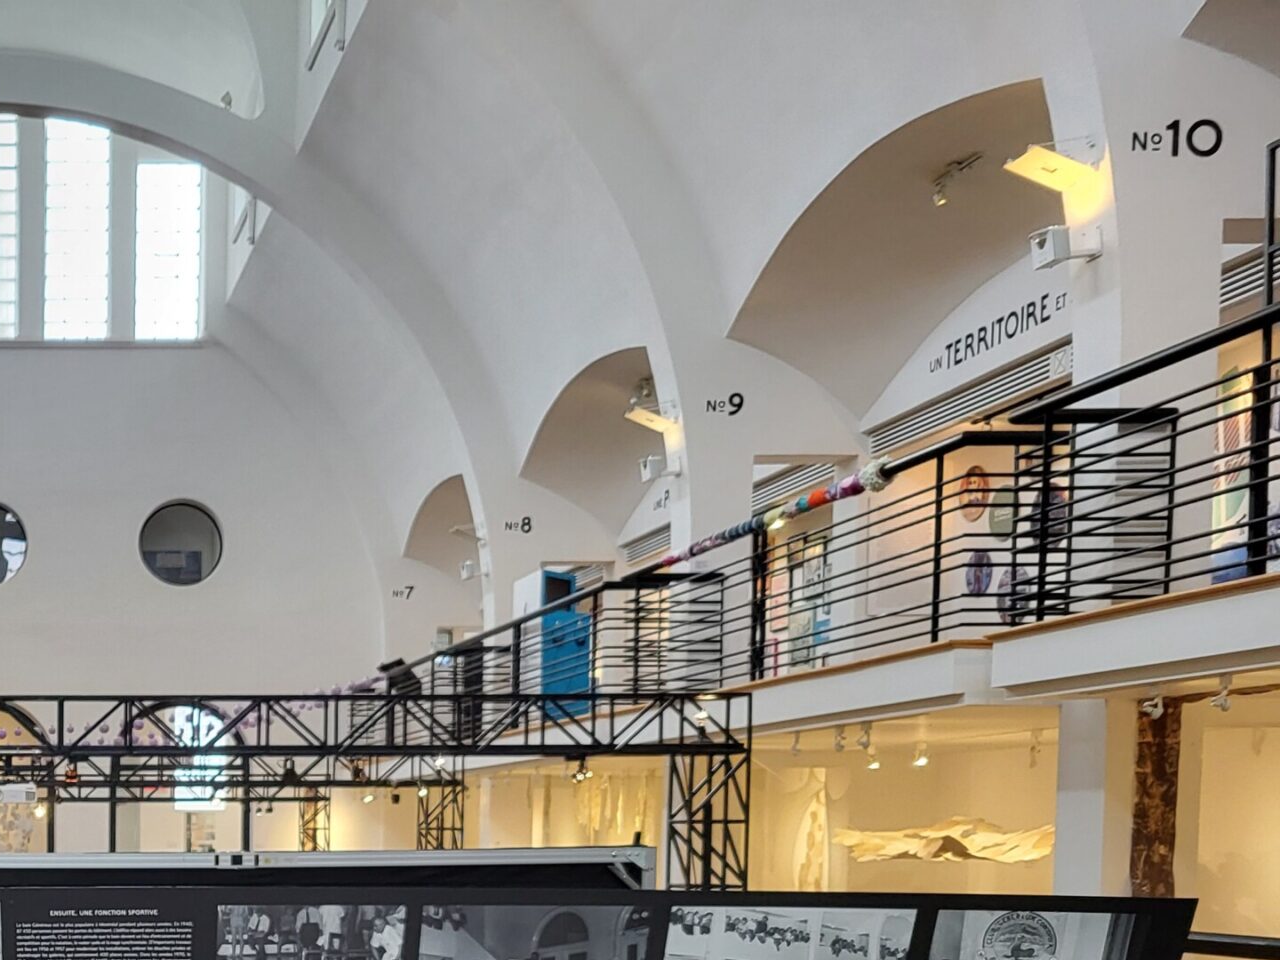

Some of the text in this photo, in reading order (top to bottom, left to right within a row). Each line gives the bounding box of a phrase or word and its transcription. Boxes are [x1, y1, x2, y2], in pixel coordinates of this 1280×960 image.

[944, 293, 1051, 370] TERRITOIRE
[1055, 292, 1068, 311] ET
[94, 908, 127, 916] FONCTION
